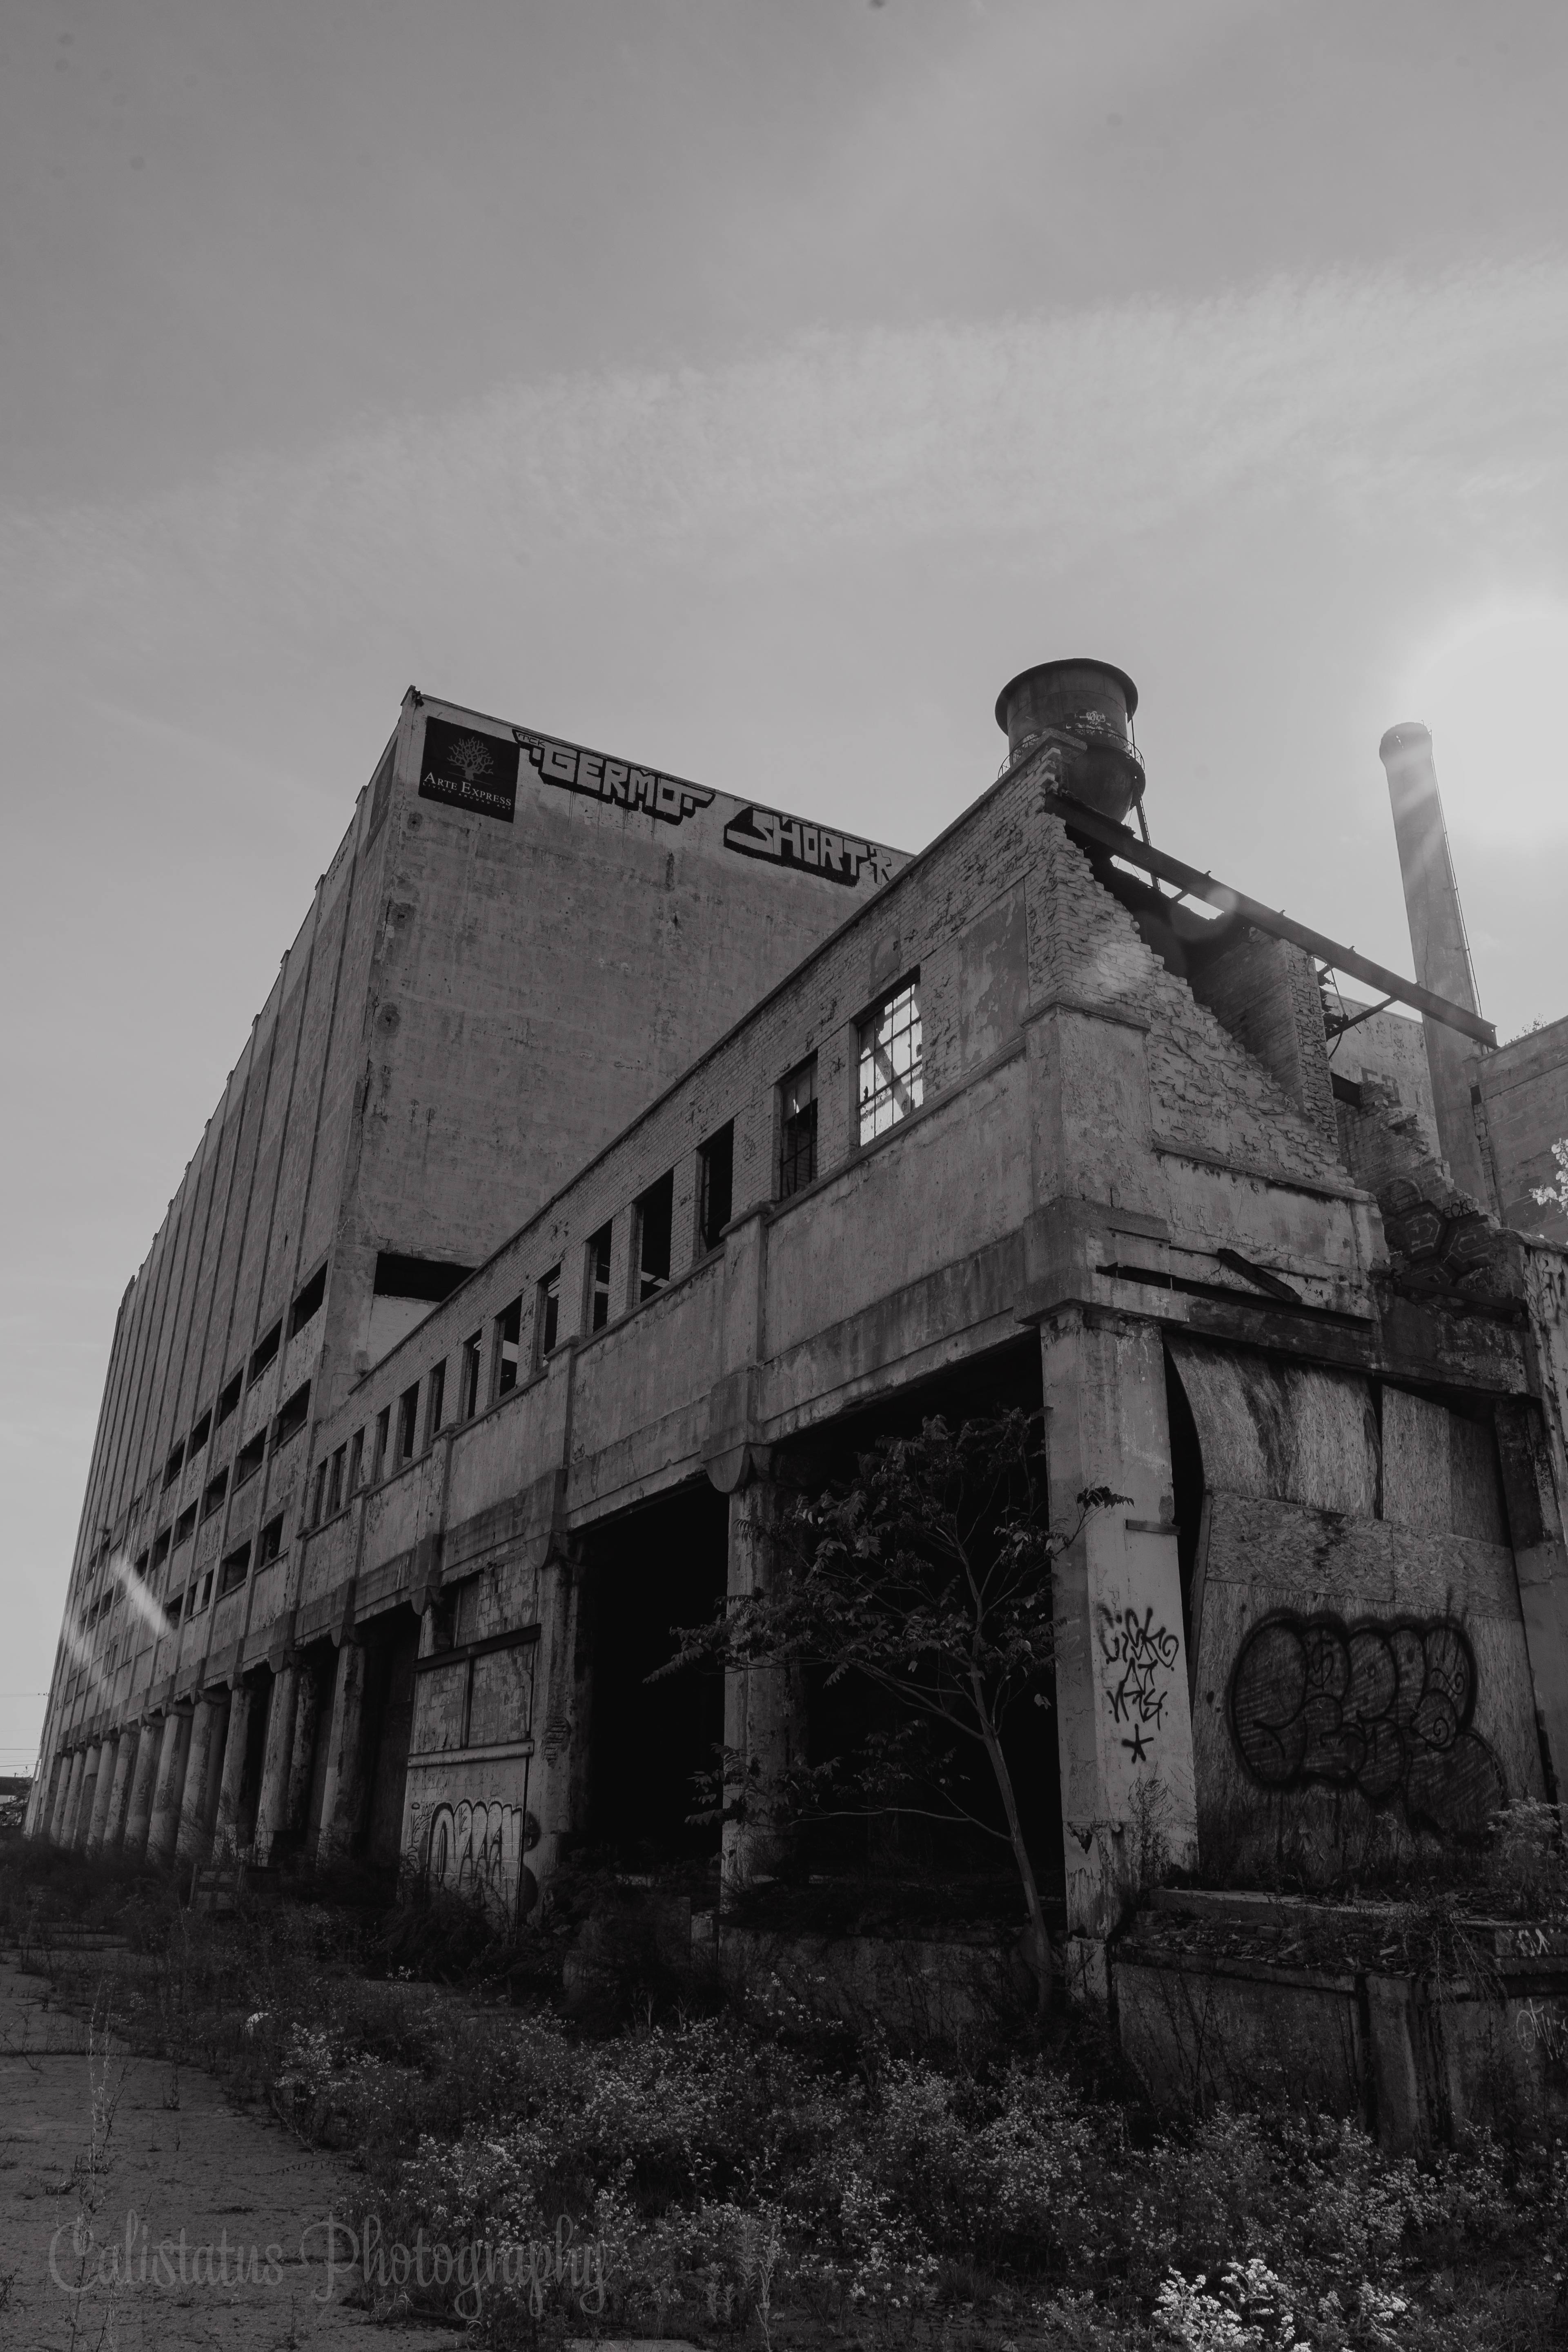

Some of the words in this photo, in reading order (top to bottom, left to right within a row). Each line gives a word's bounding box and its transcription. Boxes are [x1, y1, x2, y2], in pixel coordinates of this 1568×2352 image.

[423, 772, 458, 791] ARTE
[460, 781, 512, 806] EXPRESS
[423, 782, 452, 793] LIVING
[458, 793, 490, 804] AROUND
[724, 806, 871, 887] SHORT
